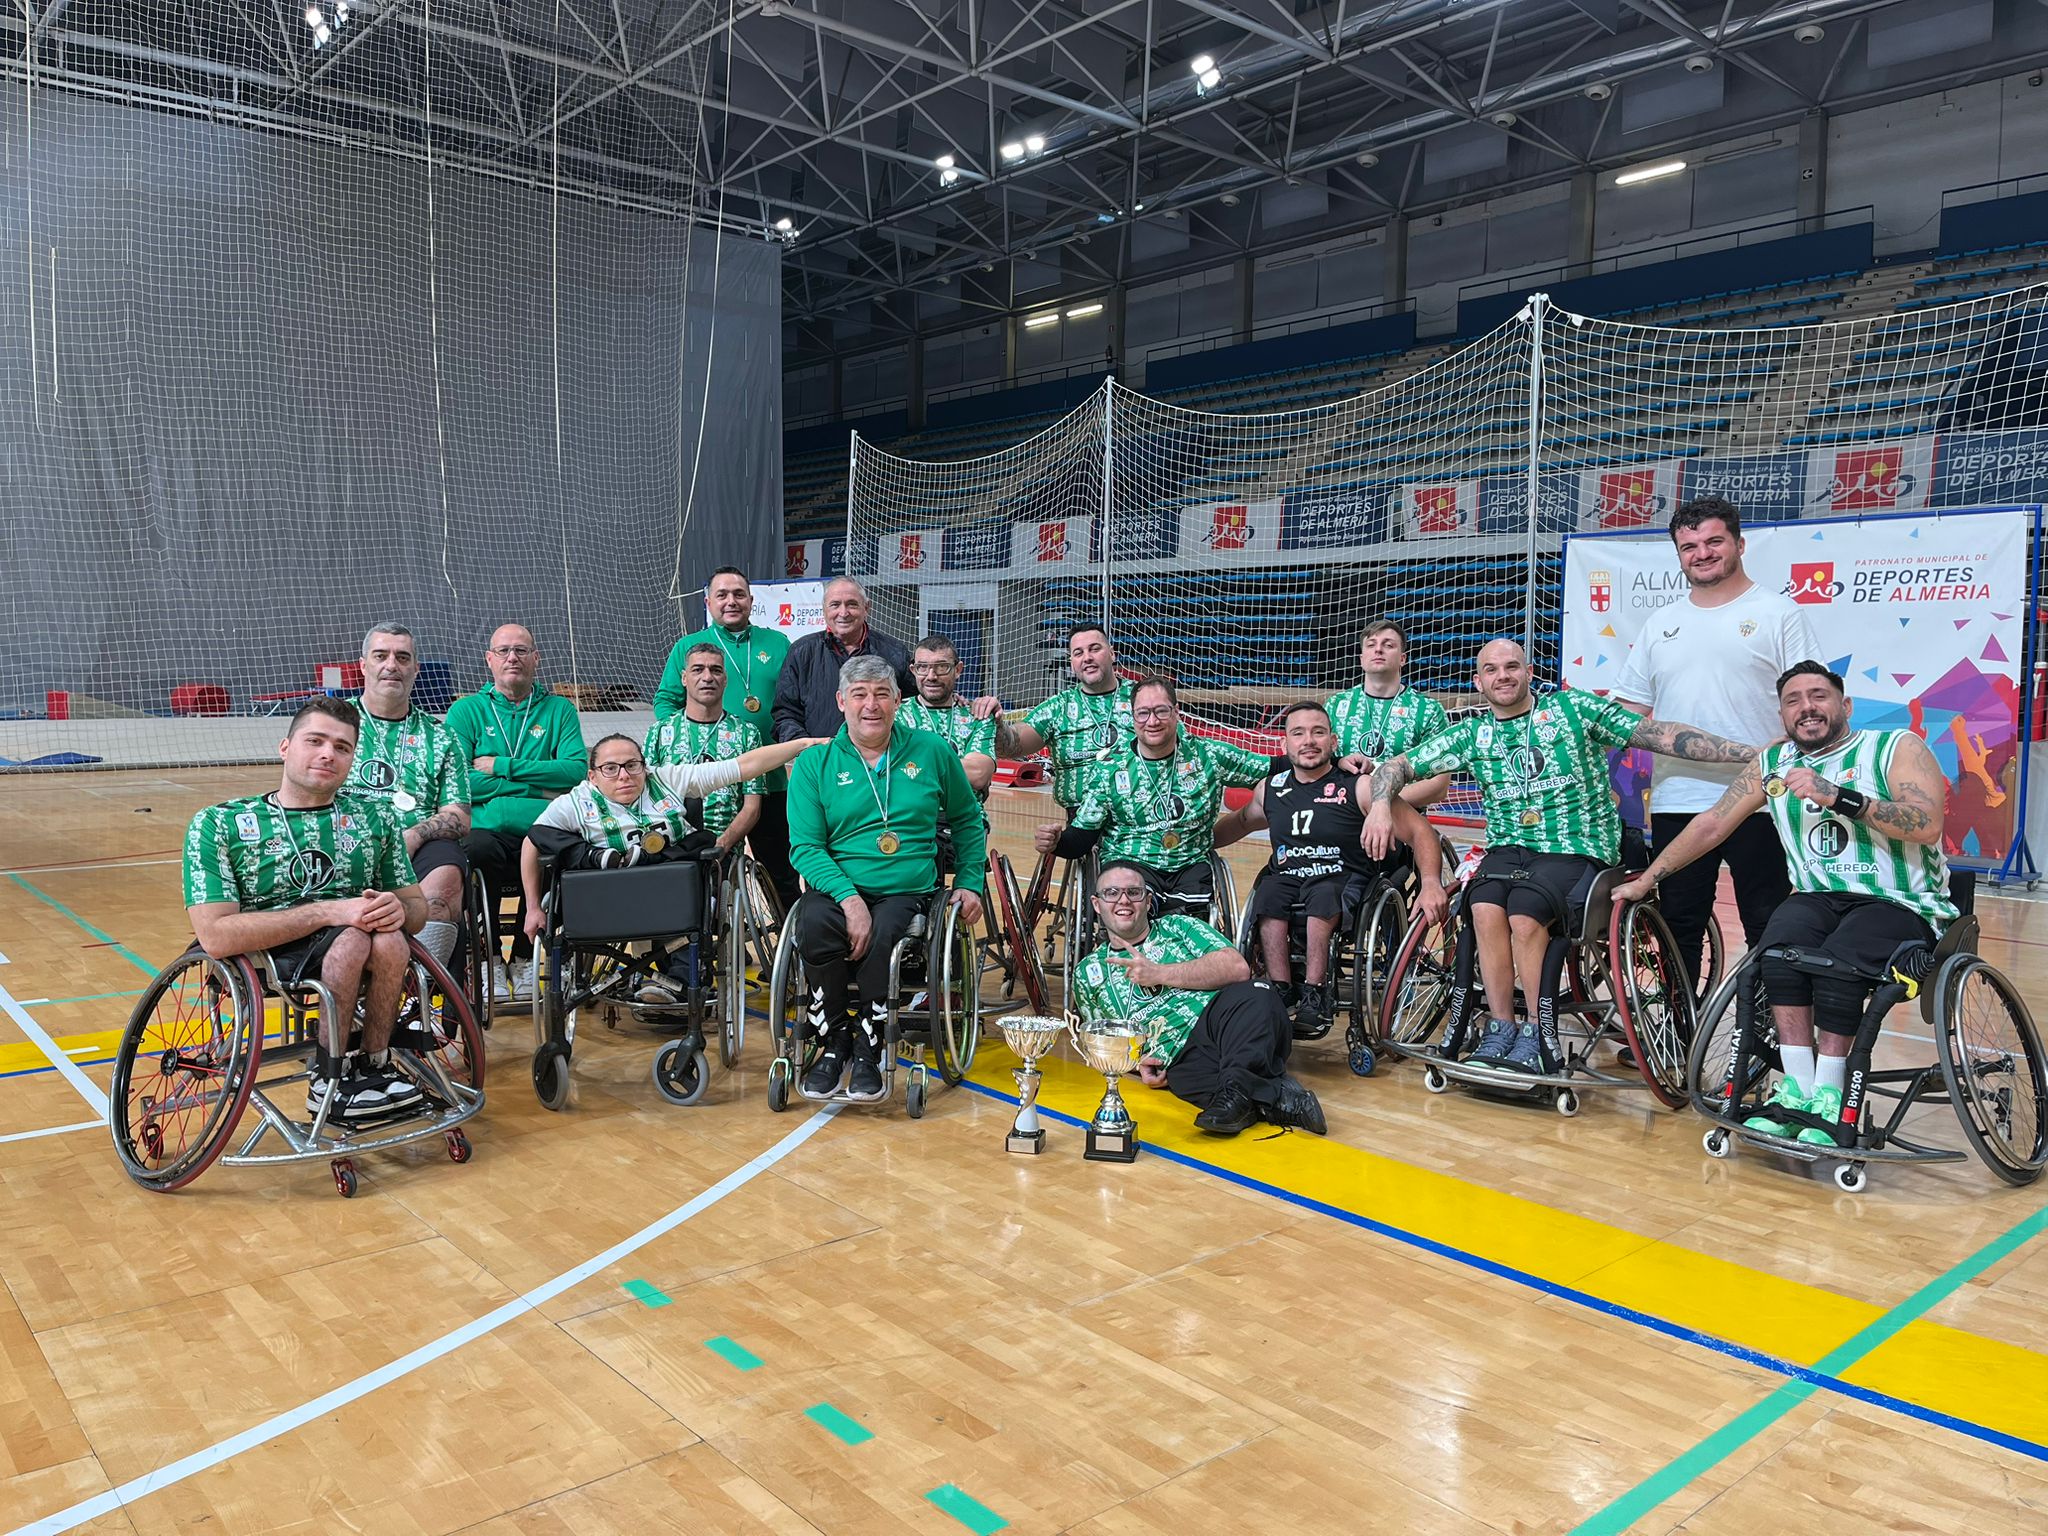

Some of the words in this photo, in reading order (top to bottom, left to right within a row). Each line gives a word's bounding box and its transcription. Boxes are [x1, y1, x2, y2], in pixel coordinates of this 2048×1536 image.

[1695, 472, 1793, 489] DEPORTES
[1950, 472, 1977, 486] DE
[1982, 466, 2048, 484] ALMER
[1490, 491, 1568, 506] DEPOTES
[1302, 502, 1373, 516] DEPORTES
[1490, 506, 1507, 517] DE
[1511, 505, 1567, 518] ALERIA
[1112, 520, 1161, 533] EPORTES
[1301, 519, 1316, 530] DE
[1317, 516, 1369, 529] ALMERIA
[1854, 556, 1914, 567] PATRONATO
[1916, 554, 1971, 564] MUNICIPAL
[1975, 552, 1989, 561] DE
[1853, 566, 1974, 587] DEPORTES
[1852, 587, 1883, 603] DE
[1888, 583, 1991, 602] ALMERIA
[796, 617, 806, 626] DE
[1071, 751, 1097, 759] GRUP
[1496, 786, 1524, 798] GRUP
[1532, 774, 1576, 791] HEREDA
[1291, 809, 1314, 836] 17
[1286, 845, 1341, 858] eCoCulture
[1826, 863, 1880, 873] HEREDA
[1130, 1004, 1155, 1026] RUPO
[1727, 1028, 1743, 1079] TARMAK
[1847, 1070, 1864, 1108] BW500
